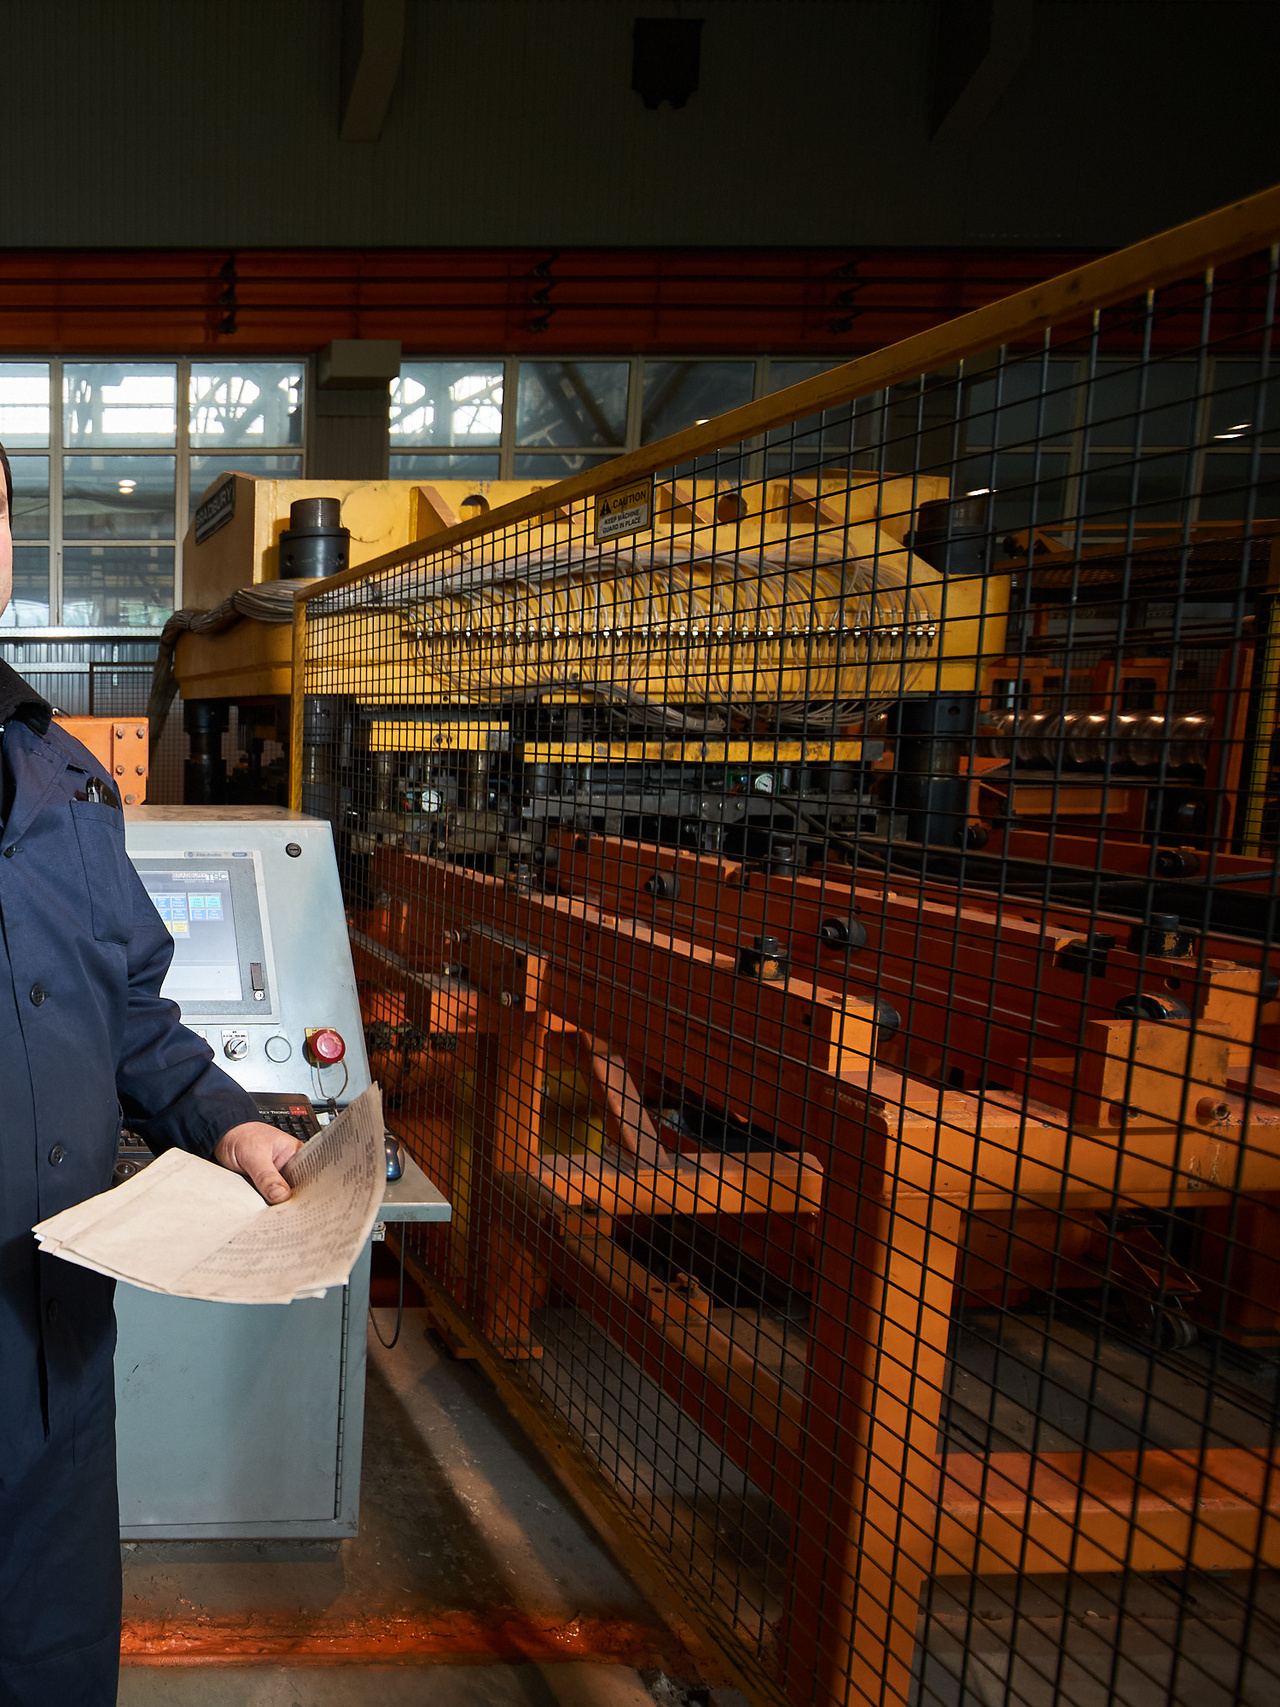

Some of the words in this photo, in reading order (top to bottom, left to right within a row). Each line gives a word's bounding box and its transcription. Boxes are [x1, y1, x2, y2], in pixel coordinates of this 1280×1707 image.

[613, 490, 646, 508] CAUTION
[602, 523, 619, 534] GUARD
[625, 516, 642, 527] PLACE
[604, 515, 616, 524] KEEP
[617, 509, 639, 520] MACHINE
